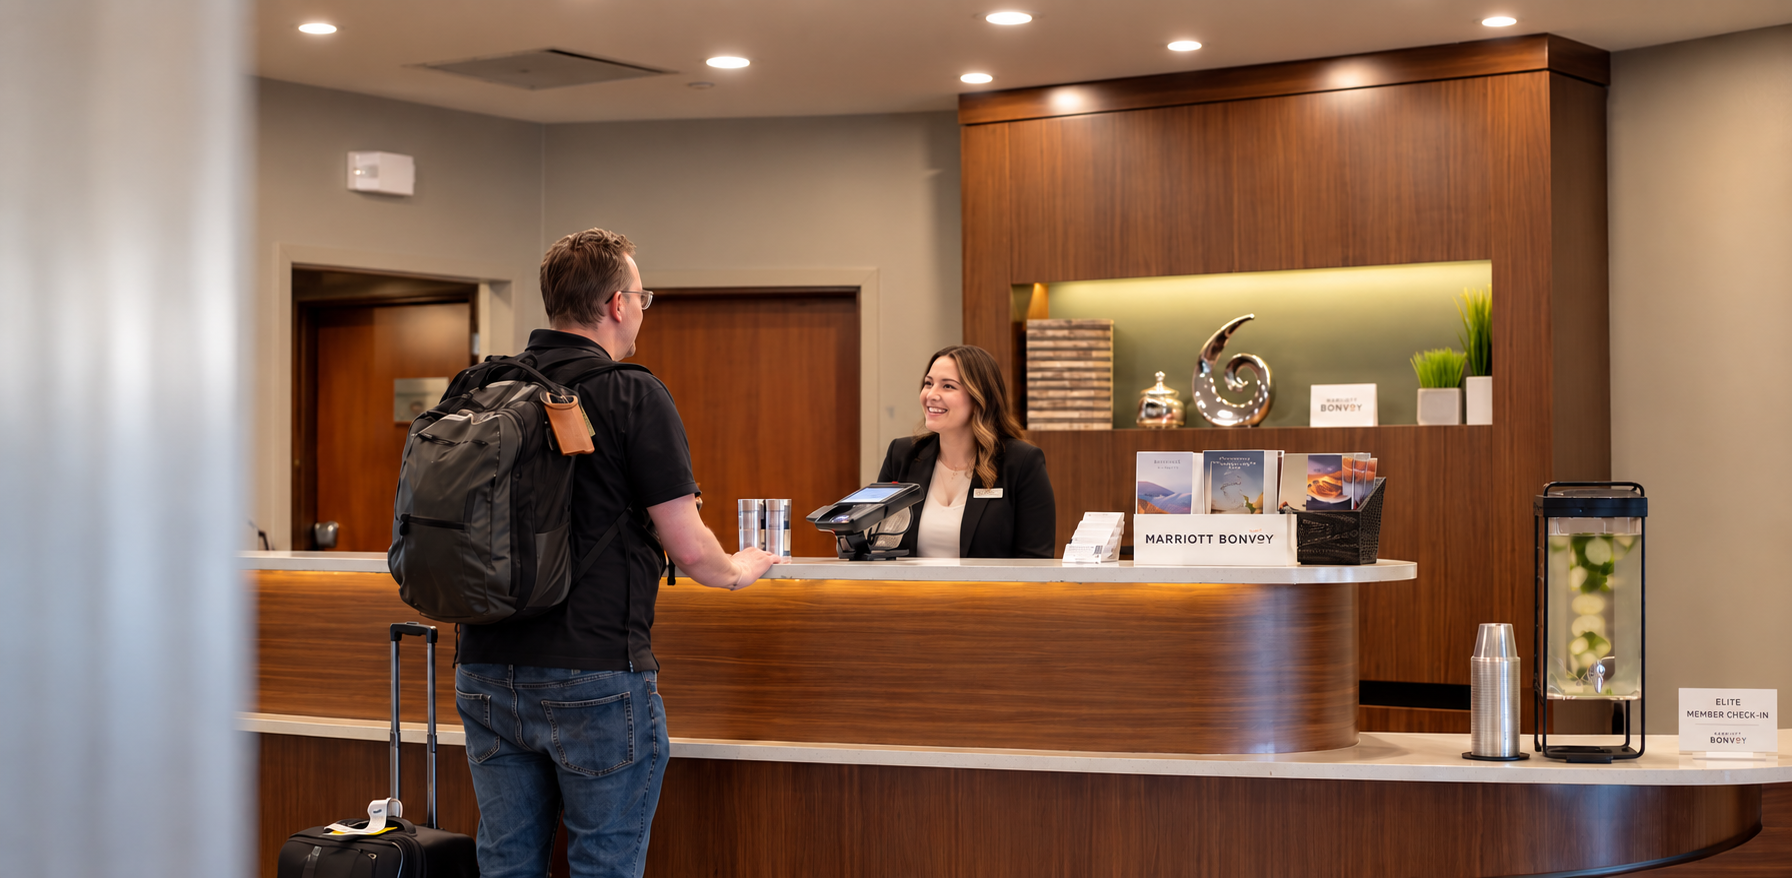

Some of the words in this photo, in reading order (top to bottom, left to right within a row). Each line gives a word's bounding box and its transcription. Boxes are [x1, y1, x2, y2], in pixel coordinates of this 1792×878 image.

[1320, 404, 1362, 412] BONVOY
[1145, 534, 1214, 544] MARRIOTT
[1219, 534, 1274, 544] BONVOY
[1715, 698, 1741, 706] ELITE
[1686, 710, 1724, 719] MEMBER
[1726, 711, 1769, 719] CHECK-IN
[1710, 736, 1747, 744] BONVOY
